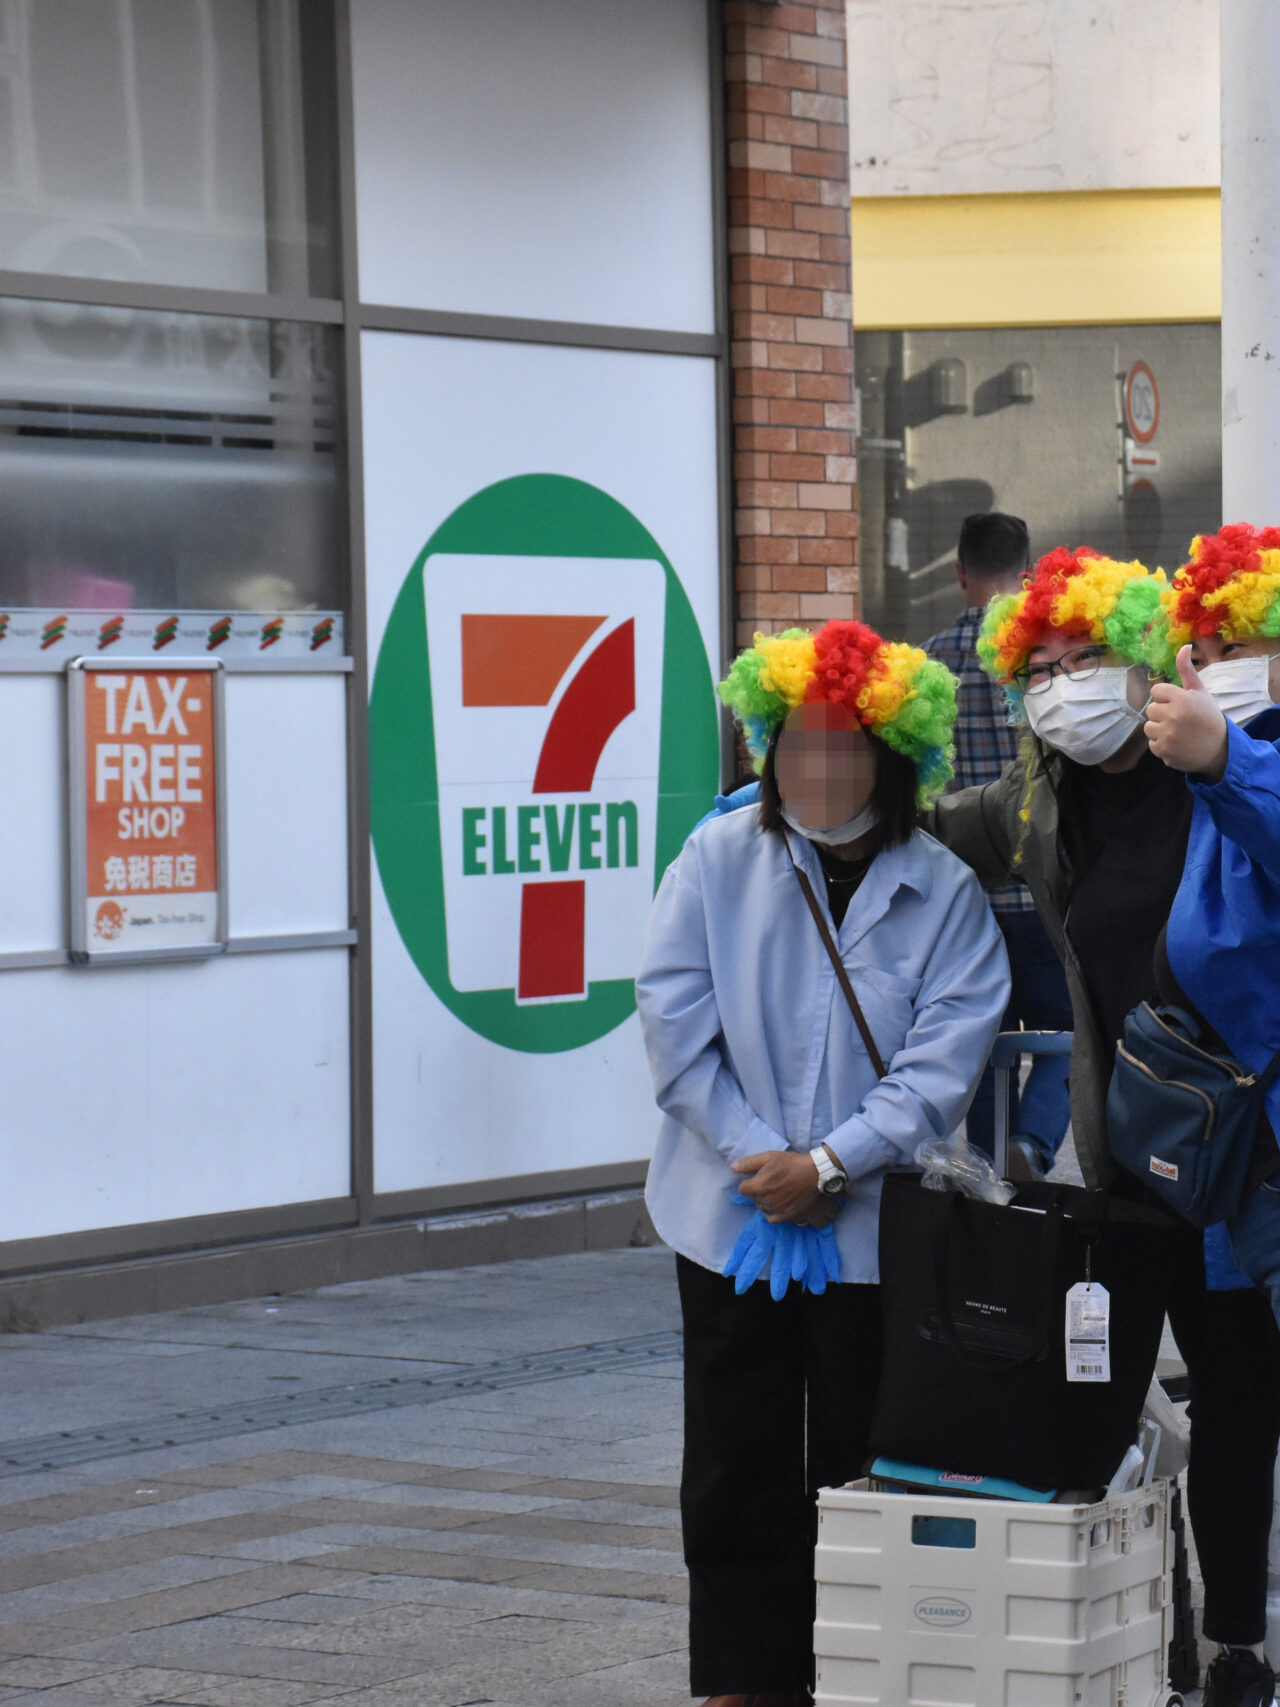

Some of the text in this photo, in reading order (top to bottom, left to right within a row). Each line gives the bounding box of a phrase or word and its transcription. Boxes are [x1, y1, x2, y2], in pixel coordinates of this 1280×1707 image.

[95, 674, 202, 736] TAX-
[95, 743, 203, 803] FREE
[117, 805, 186, 839] SHOP
[104, 853, 197, 891] 免税商店
